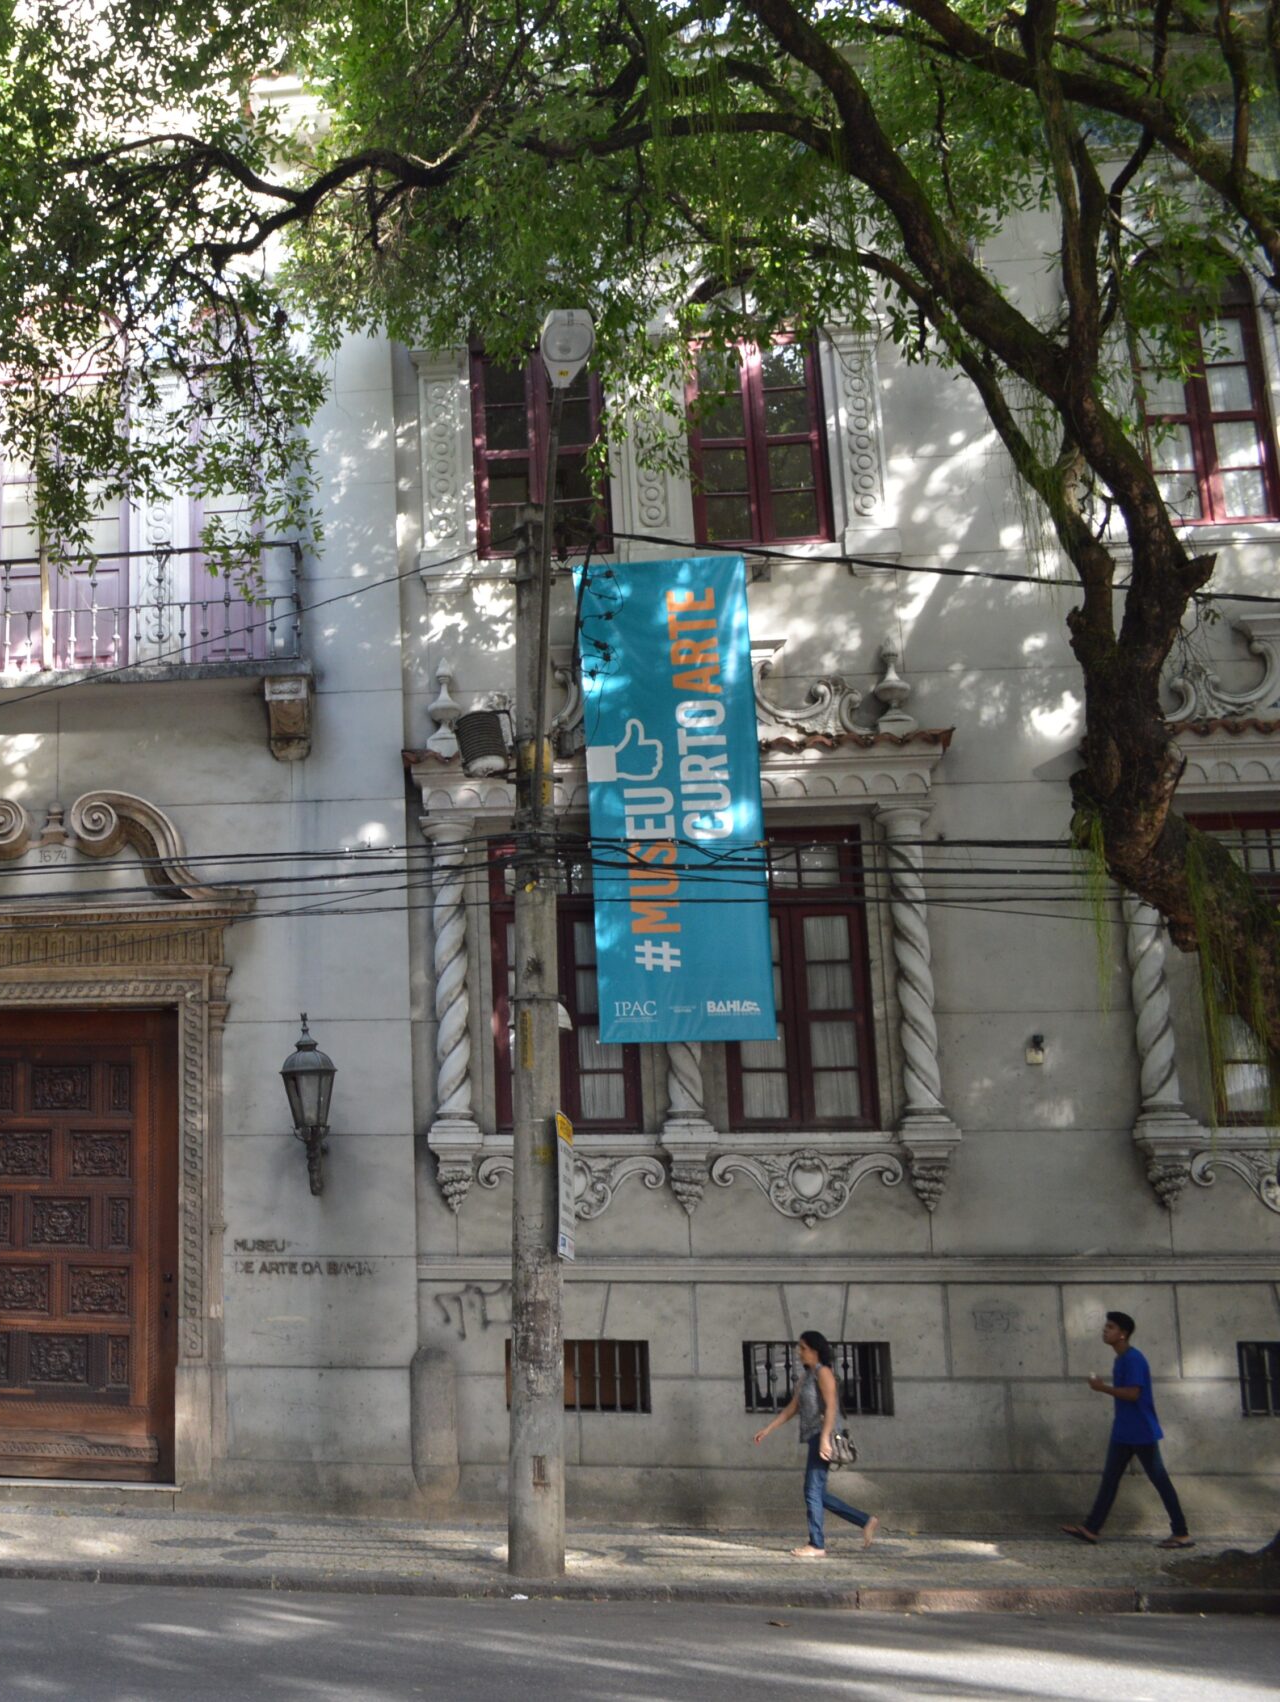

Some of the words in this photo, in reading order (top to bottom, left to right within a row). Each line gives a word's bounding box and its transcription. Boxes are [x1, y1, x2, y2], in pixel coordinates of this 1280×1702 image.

[38, 848, 68, 864] 1674
[614, 1000, 657, 1017] IPAC
[706, 1000, 761, 1013] BAHIA
[233, 1238, 287, 1252] MUSEU
[234, 1261, 255, 1275] DE
[258, 1261, 298, 1276] ARTE
[301, 1261, 323, 1275] DA
[326, 1262, 373, 1276] BAHIA
